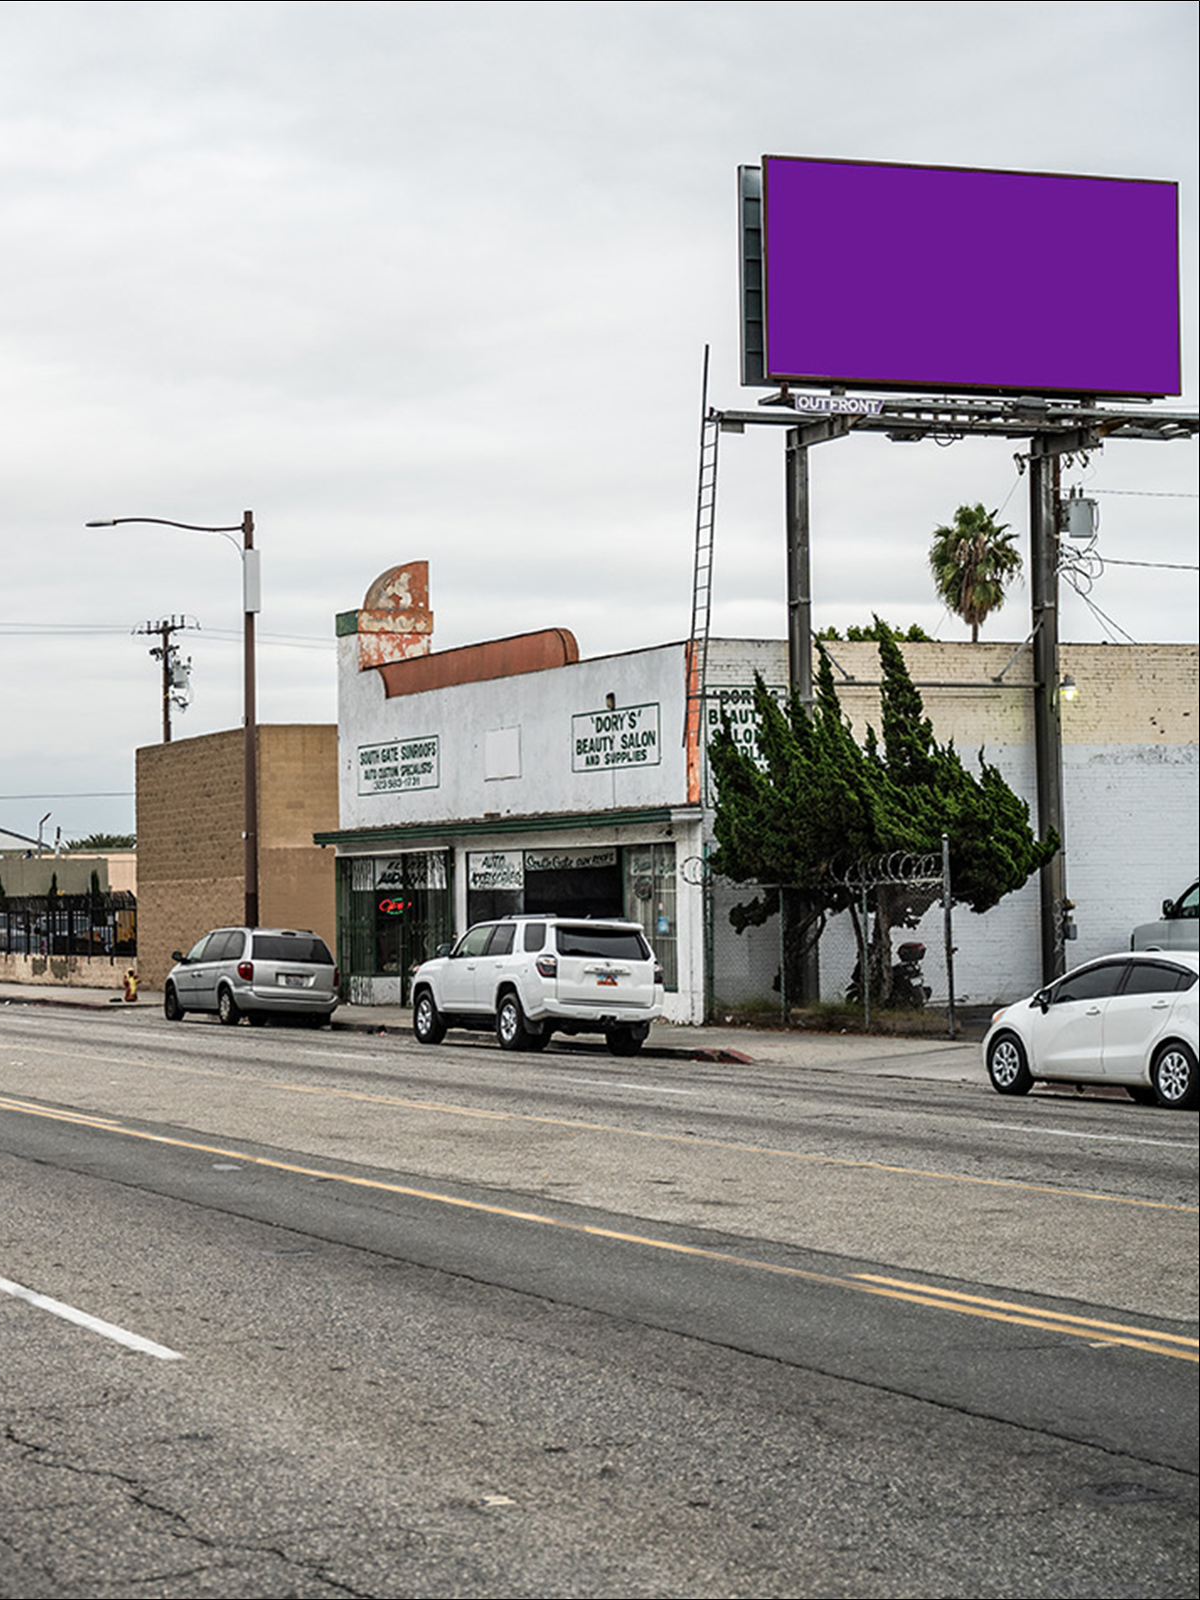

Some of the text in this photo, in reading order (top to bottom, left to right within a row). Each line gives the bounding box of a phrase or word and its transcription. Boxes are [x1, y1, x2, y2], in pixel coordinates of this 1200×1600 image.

[798, 396, 880, 413] OUTFRONT
[576, 730, 657, 756] BEAUTY SALON
[360, 750, 380, 766] SOUTH
[381, 747, 399, 762] GATE
[585, 749, 648, 767] AND SUPPLIES
[481, 854, 506, 869] AUTO
